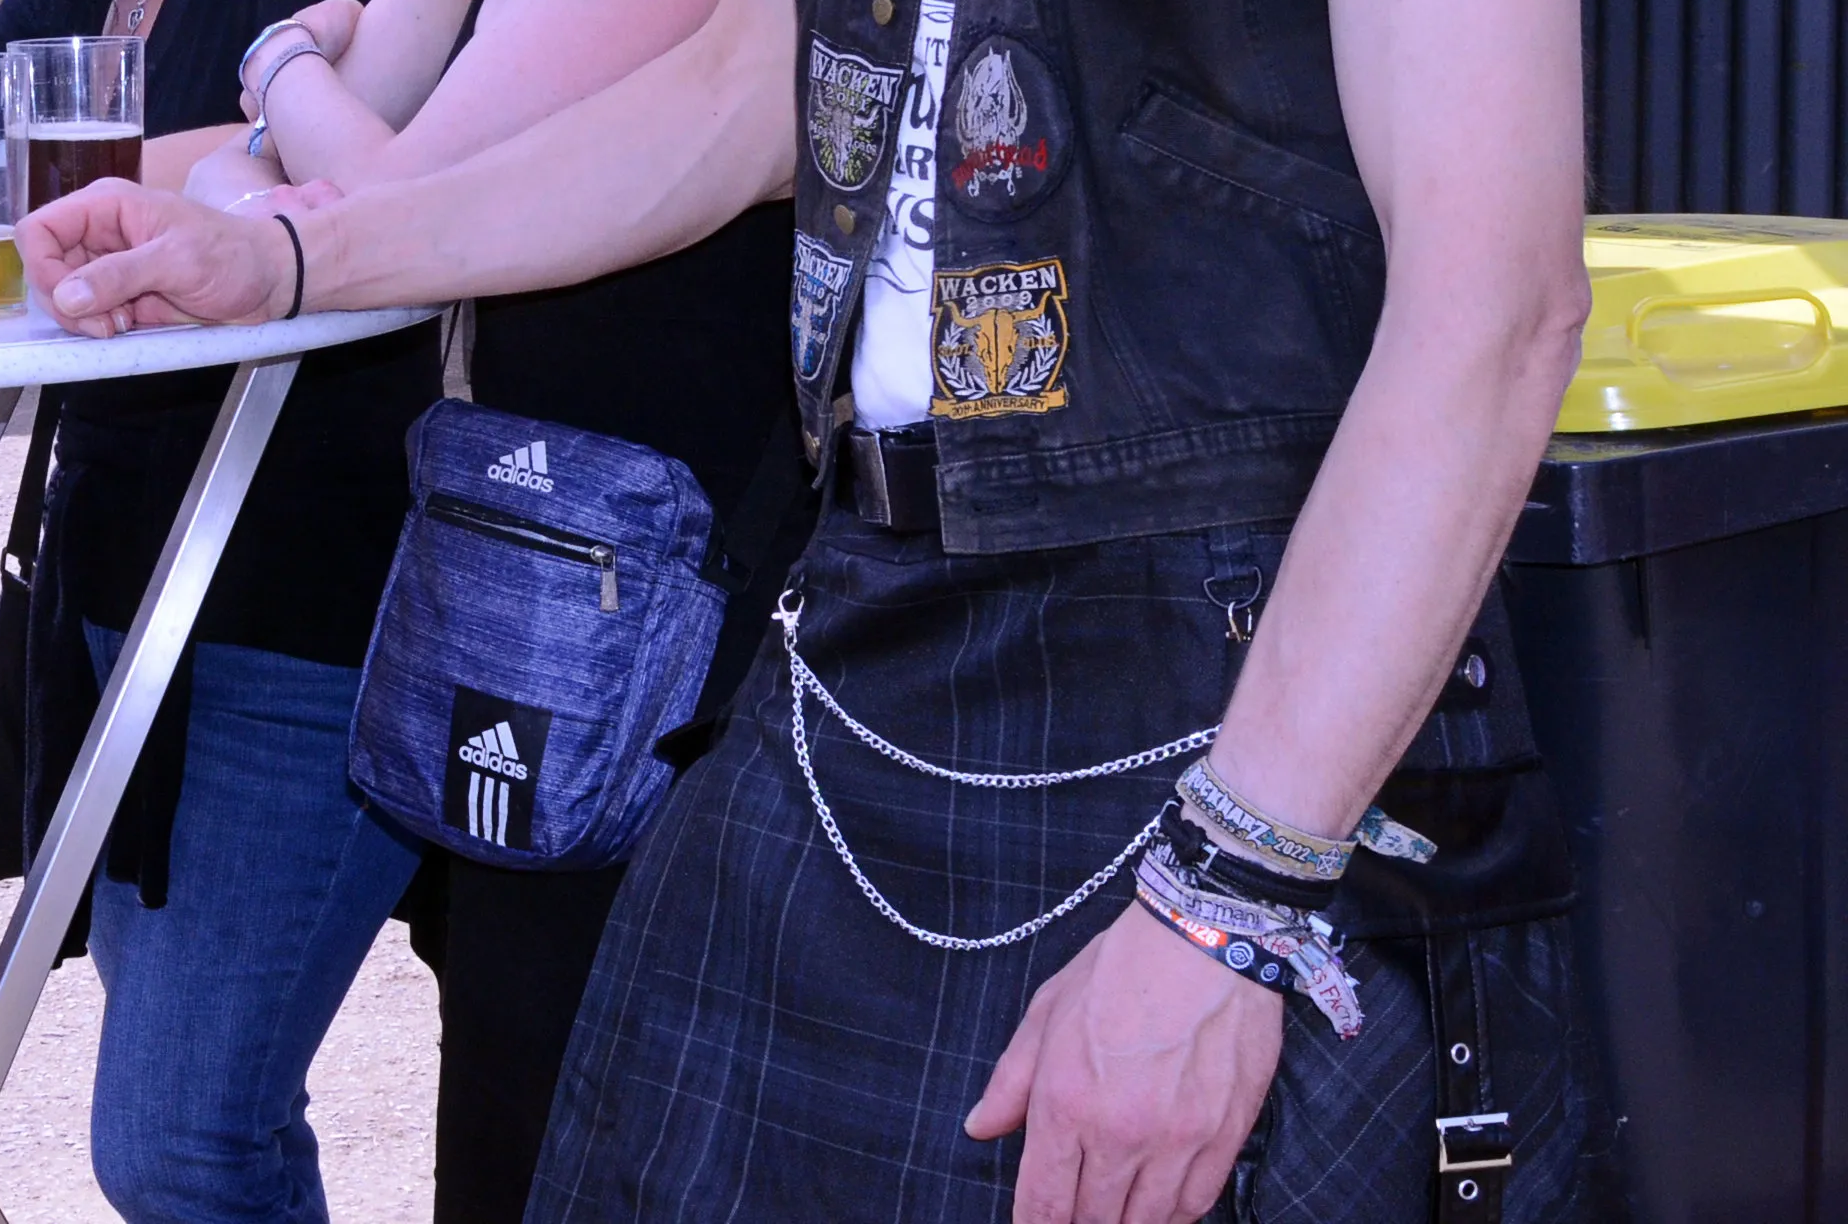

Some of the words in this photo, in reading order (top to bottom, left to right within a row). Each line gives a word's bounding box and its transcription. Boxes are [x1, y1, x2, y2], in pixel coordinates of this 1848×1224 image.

[812, 47, 898, 105] WACKEN
[824, 85, 869, 112] 2011
[939, 266, 1057, 301] WACKEN
[966, 290, 1033, 311] 2009
[974, 396, 1045, 413] ANNIVERSARY
[487, 463, 554, 493] adidas
[459, 745, 527, 780] adidas
[1183, 764, 1273, 848] ROCKHARZ
[1273, 835, 1313, 863] 2022
